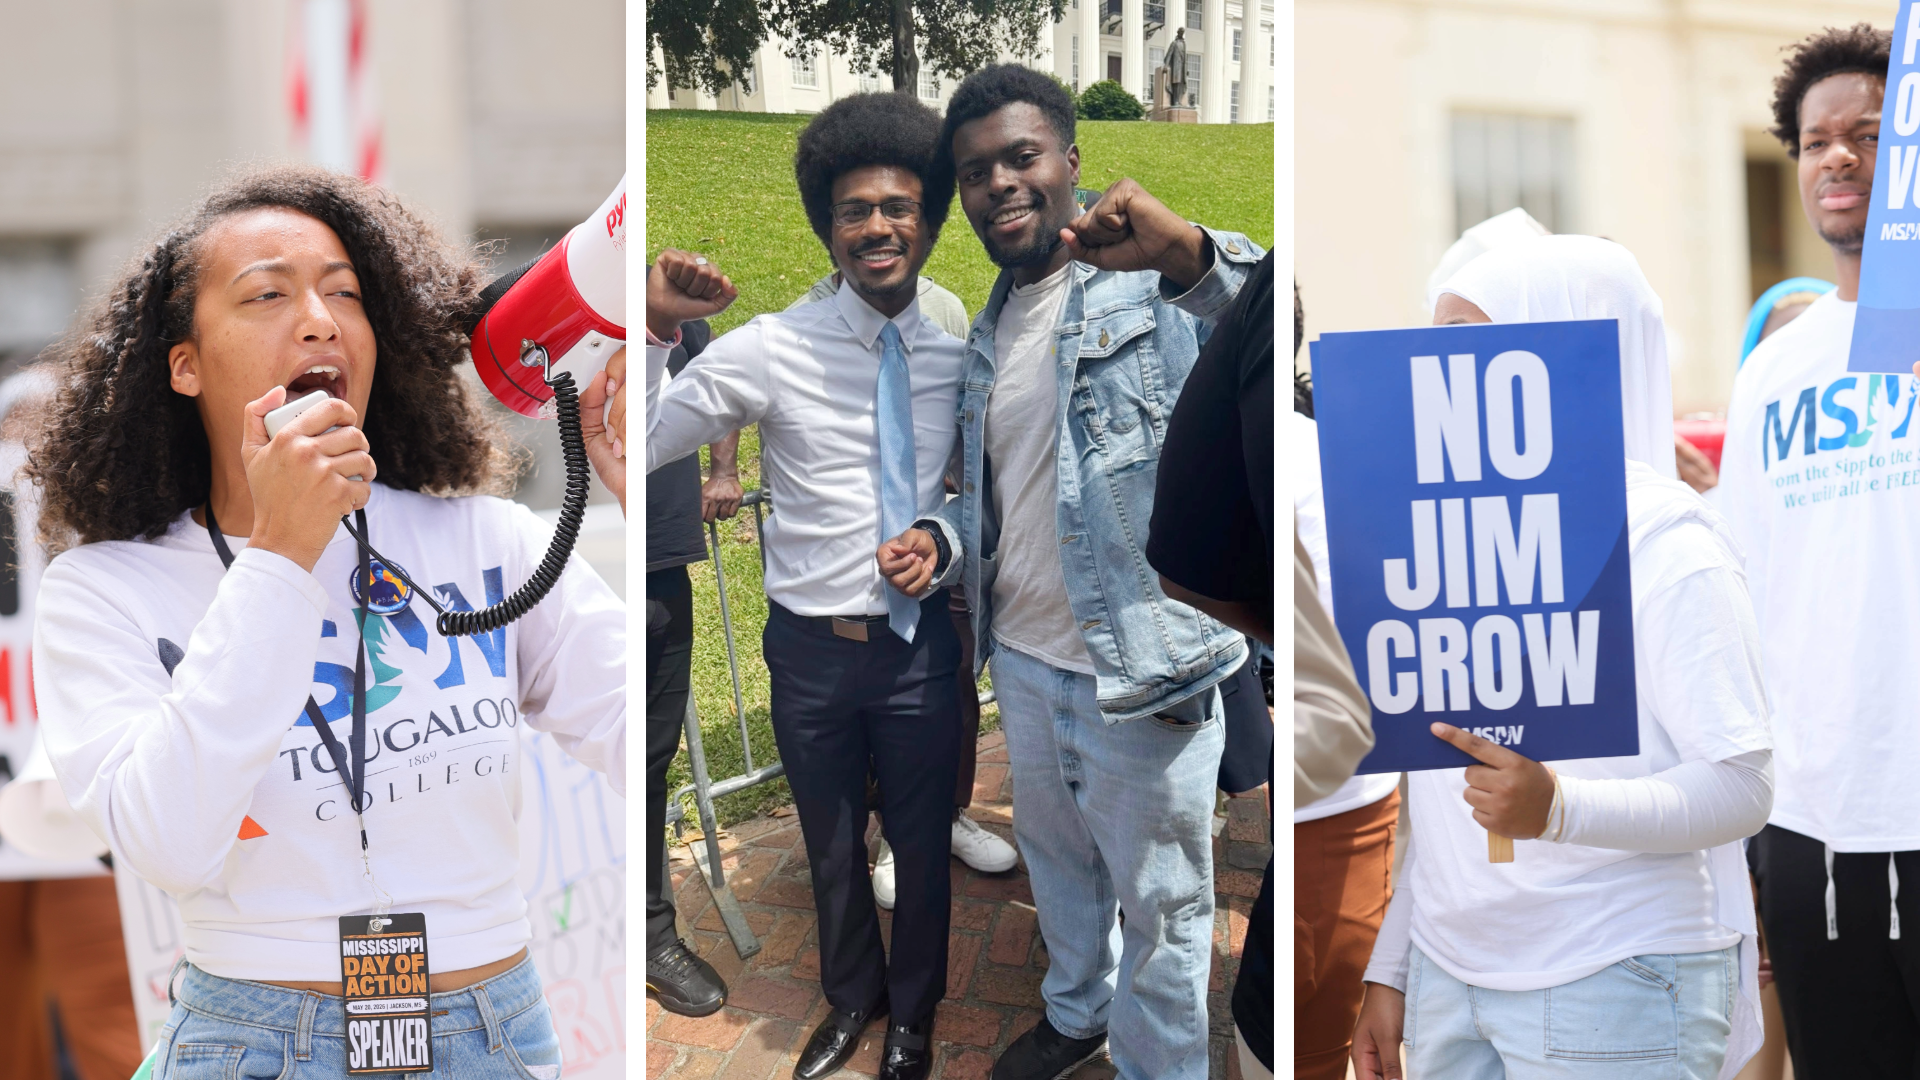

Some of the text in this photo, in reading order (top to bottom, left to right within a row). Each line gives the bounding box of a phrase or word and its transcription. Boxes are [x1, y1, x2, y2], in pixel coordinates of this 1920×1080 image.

[1410, 349, 1553, 484] NO
[1806, 465, 1829, 481] the
[1869, 453, 1886, 468] to
[1891, 449, 1913, 465] the
[1784, 493, 1807, 509] We
[1839, 480, 1859, 498] all
[1383, 493, 1565, 612] JIM
[1366, 609, 1600, 715] CROW
[279, 697, 517, 782] TOUGALOO
[408, 750, 438, 768] 1869
[315, 753, 510, 822] COLLEGE
[342, 937, 424, 957] MISSISSIPPI
[343, 953, 425, 977] DAY OF
[345, 972, 427, 997] ACTION
[389, 1002, 413, 1010] JACKSON,
[348, 1018, 430, 1069] SPEAKER
